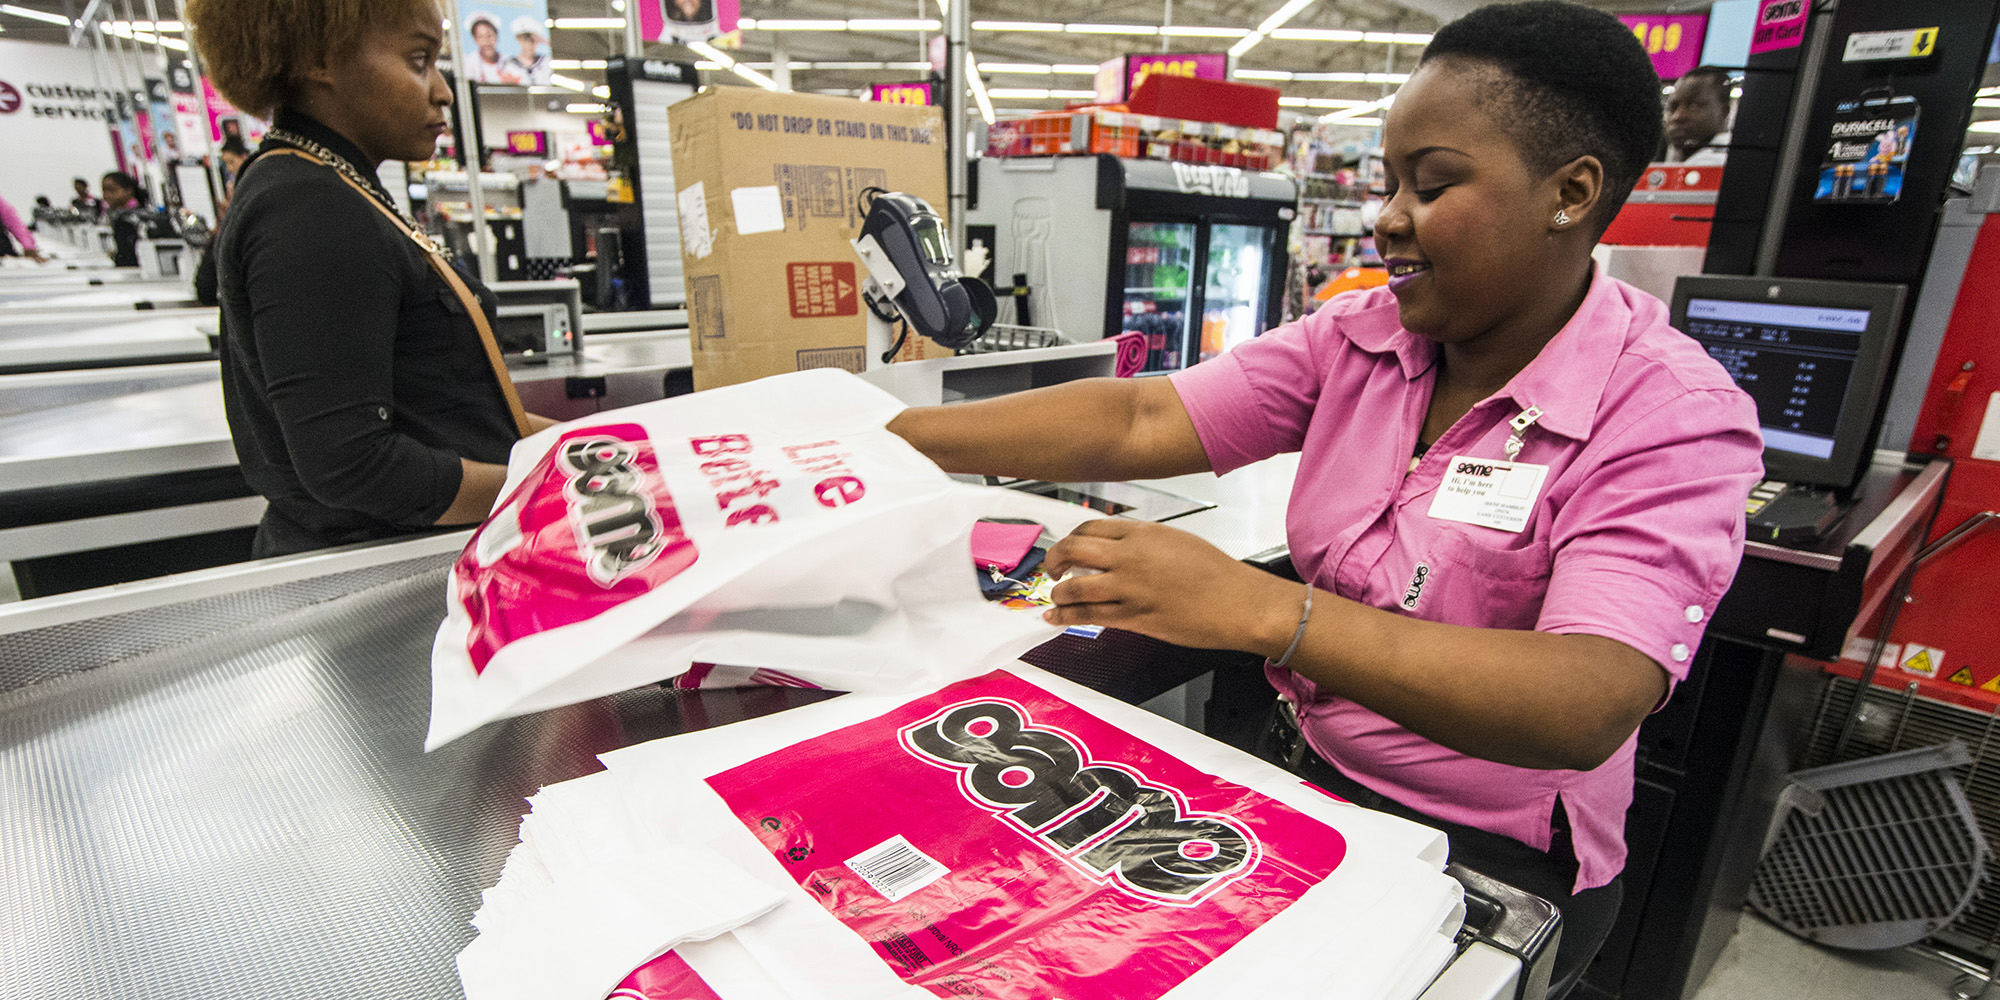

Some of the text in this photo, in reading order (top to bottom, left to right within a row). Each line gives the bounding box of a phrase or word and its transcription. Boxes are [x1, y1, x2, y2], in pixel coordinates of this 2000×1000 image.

[757, 114, 778, 132] NOT
[782, 116, 813, 134] DROP
[816, 118, 831, 136] OR
[835, 120, 867, 139] STAND
[870, 123, 884, 140] ON
[886, 125, 908, 143] THIS
[1832, 119, 1895, 134] DURACELL
[793, 266, 808, 313] HELMET
[807, 266, 822, 314] WEAR A
[821, 266, 836, 313] BE SAFE
[1456, 463, 1493, 476] game
[1477, 480, 1493, 488] here
[1456, 486, 1471, 495] help
[1403, 565, 1429, 608] game
[903, 699, 1258, 903] game
[909, 946, 927, 964] FIRST
